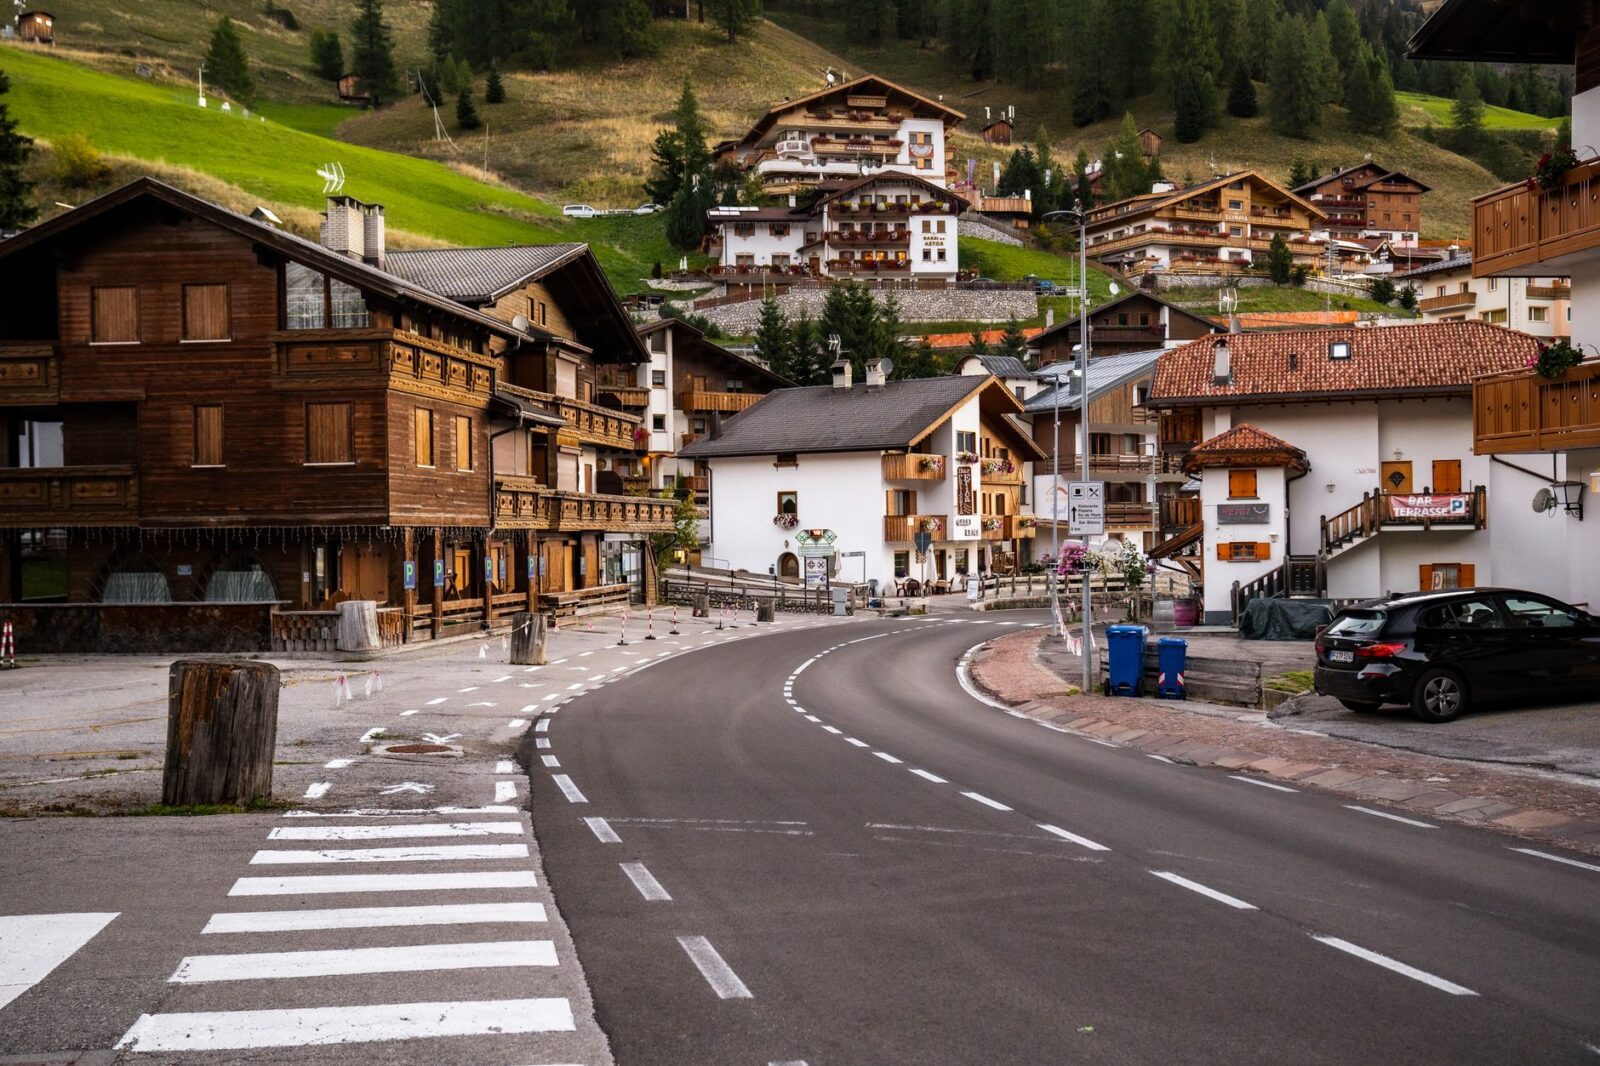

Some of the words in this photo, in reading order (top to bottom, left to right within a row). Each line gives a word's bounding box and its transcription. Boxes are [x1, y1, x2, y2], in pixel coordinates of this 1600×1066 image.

[1408, 496, 1433, 506] BAR
[1452, 499, 1463, 512] P
[1393, 507, 1448, 517] TERRASSE
[436, 562, 443, 579] P
[486, 559, 492, 575] P
[529, 558, 534, 572] P
[406, 563, 413, 582] P
